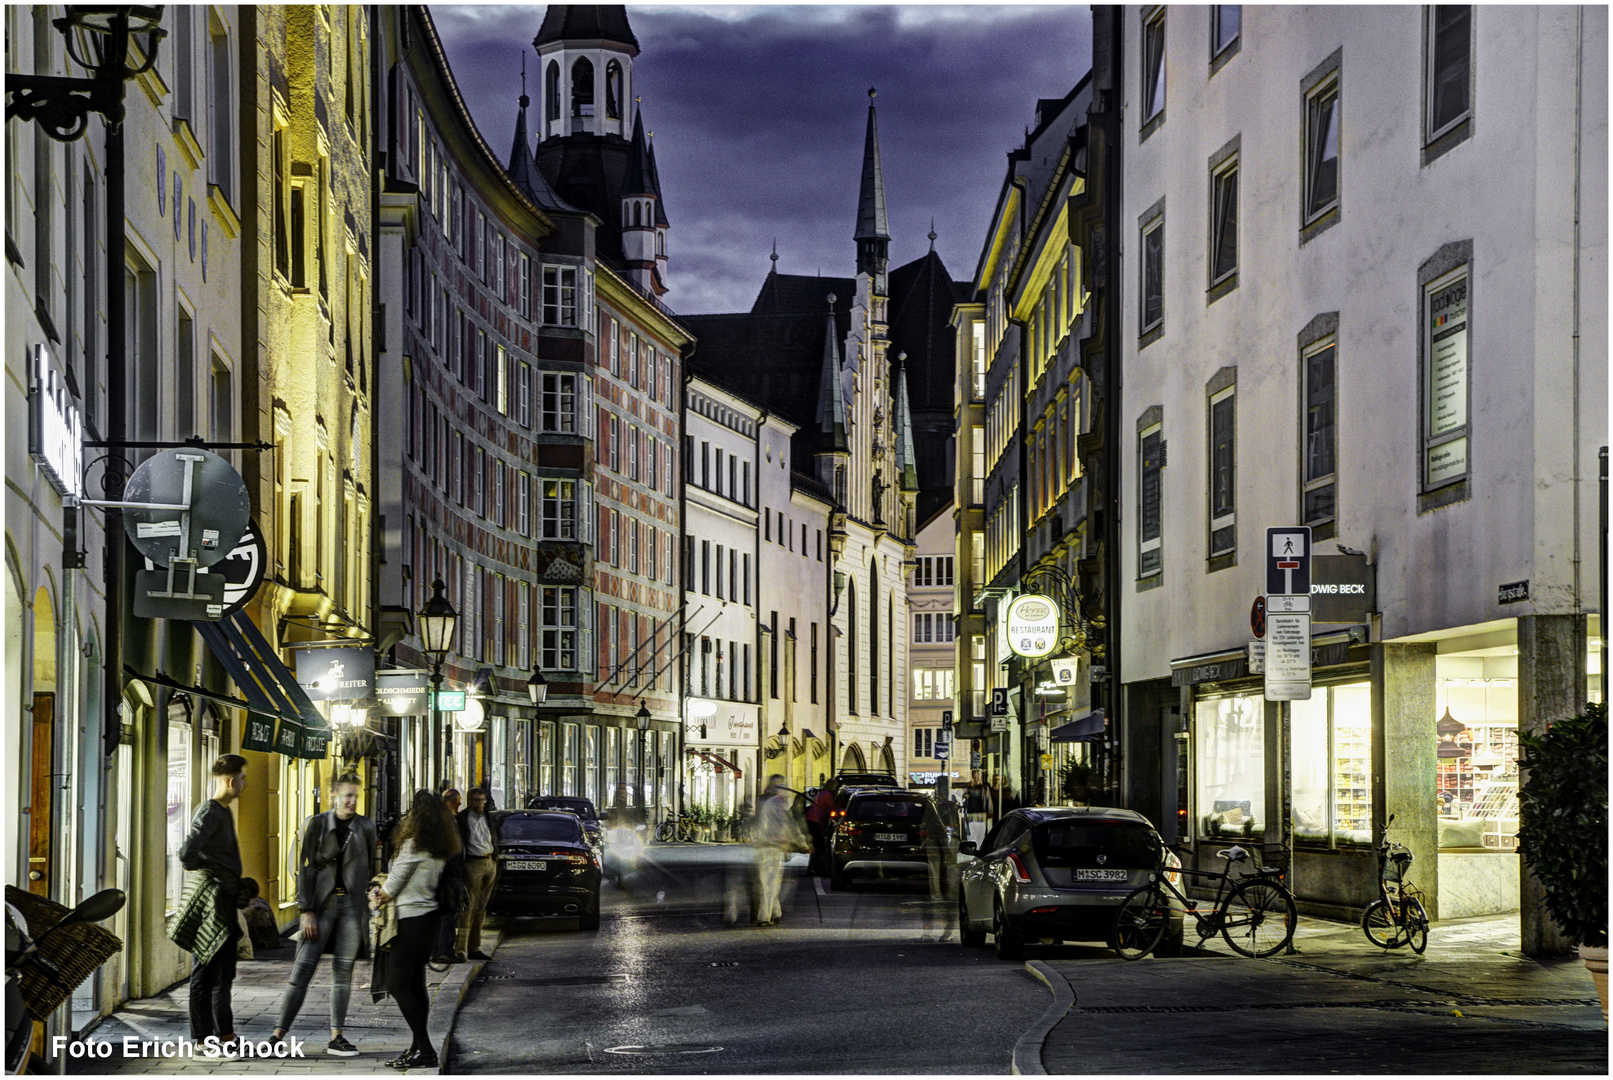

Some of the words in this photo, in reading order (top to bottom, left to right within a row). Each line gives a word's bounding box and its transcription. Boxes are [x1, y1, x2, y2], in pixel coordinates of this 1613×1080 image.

[1311, 584, 1338, 594] DWIG
[1339, 584, 1365, 594] BECK
[1011, 626, 1055, 634] RESTAURANT
[340, 680, 368, 688] REITER
[1078, 870, 1085, 878] M
[1090, 870, 1102, 878] SC
[1104, 870, 1126, 879] 3982
